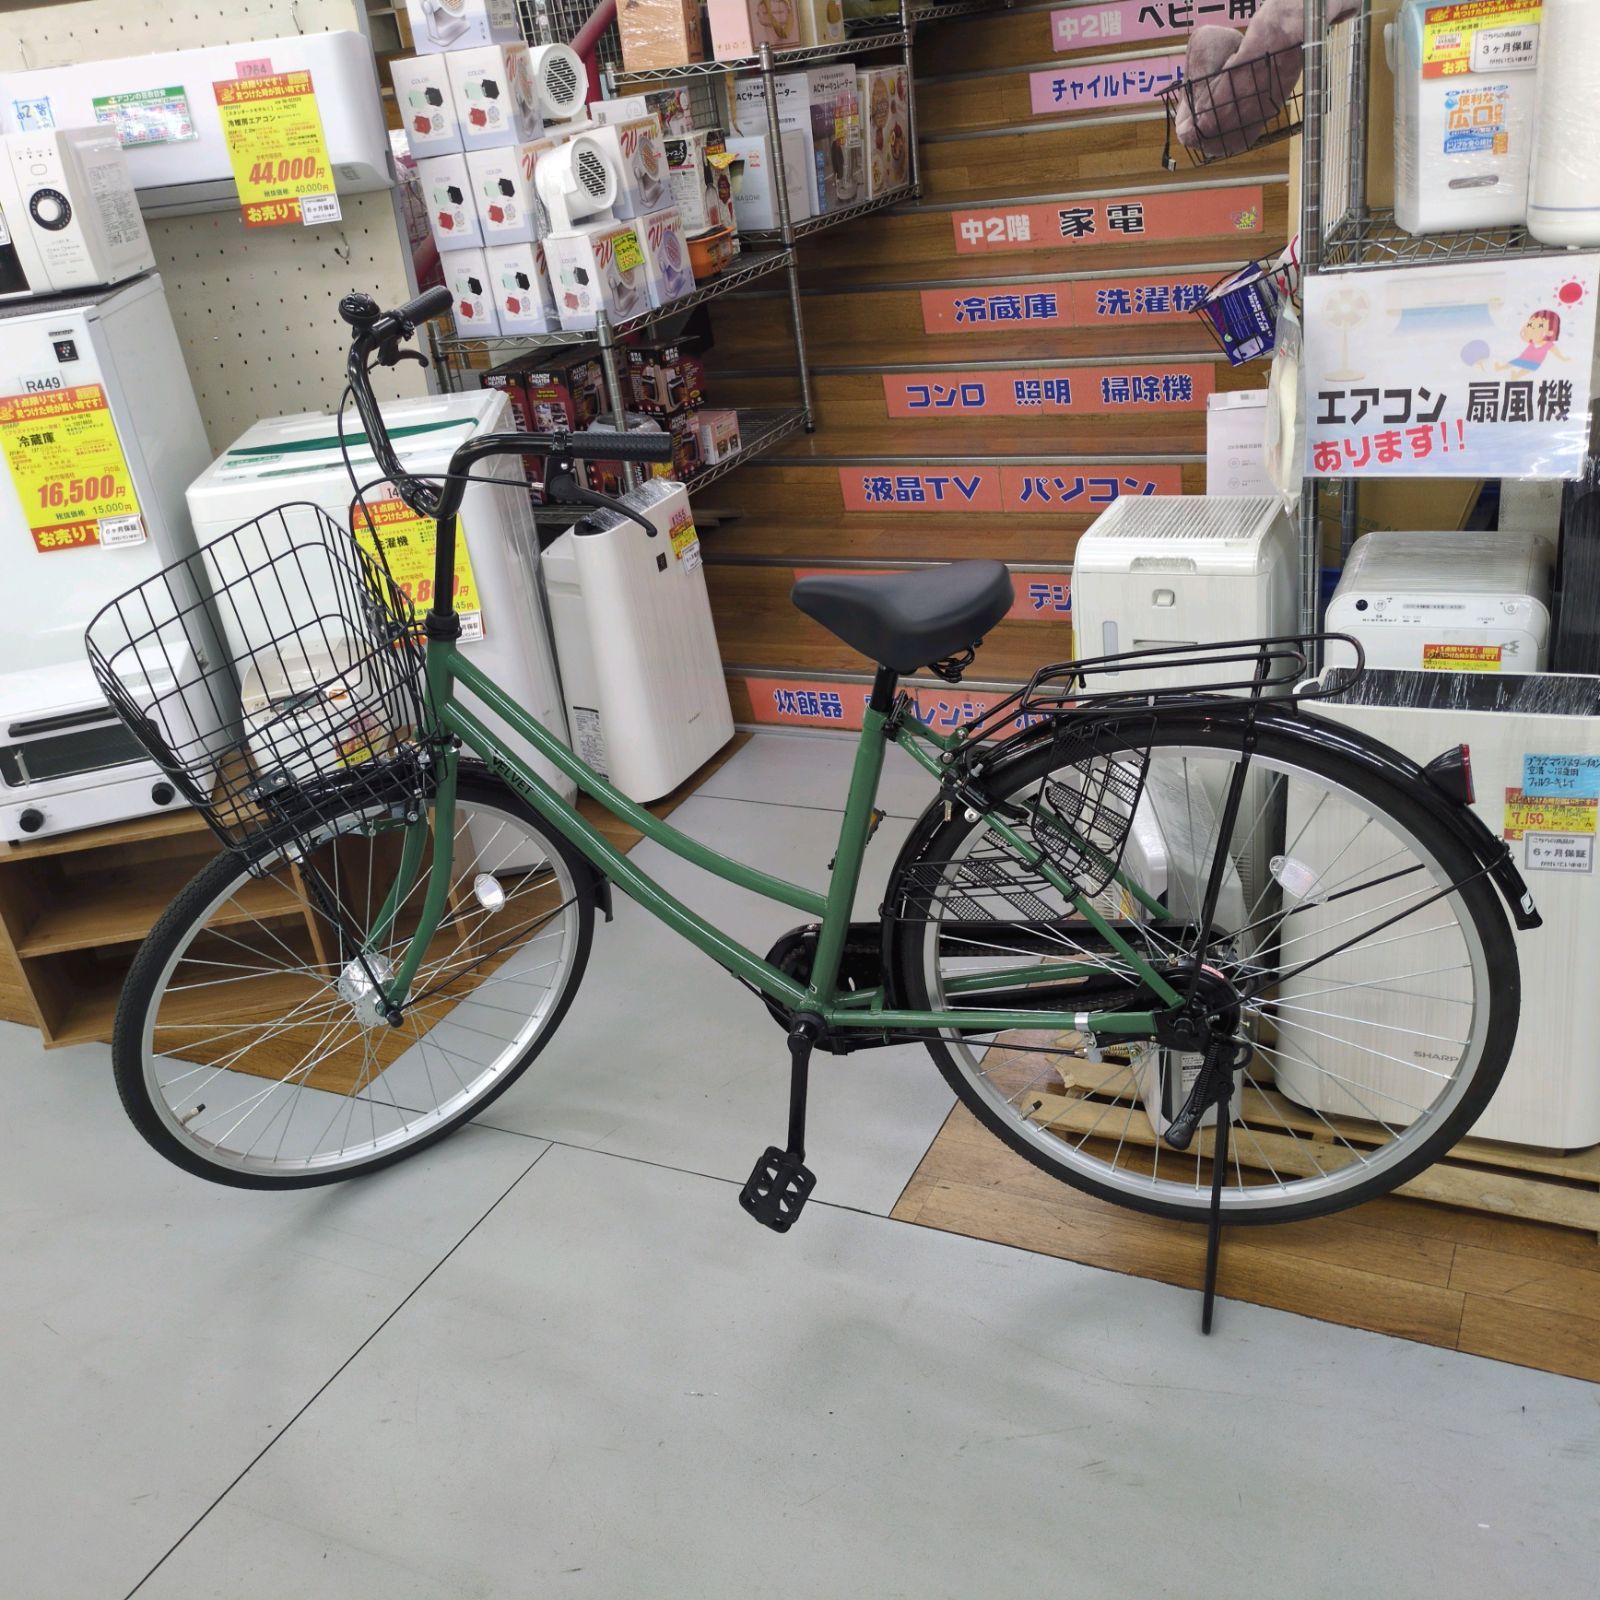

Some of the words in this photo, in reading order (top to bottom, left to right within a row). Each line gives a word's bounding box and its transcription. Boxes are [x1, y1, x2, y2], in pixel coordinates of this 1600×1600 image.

[1058, 11, 1122, 42] 中2階
[1138, 0, 1264, 29] ベビー用
[249, 156, 325, 186] 44,000円
[960, 214, 1031, 245] 中2階
[954, 292, 1059, 323] 冷蔵庫
[1096, 284, 1208, 316] 洗濯機
[26, 377, 60, 392] R449
[905, 383, 986, 409] コンロ
[1014, 378, 1072, 407] 照明
[1101, 374, 1194, 404] 掃除機
[1317, 387, 1447, 425] エアコン
[1466, 379, 1573, 424] 扇風機
[18, 432, 56, 448] 冷蔵庫
[1313, 418, 1466, 473] あります!!
[38, 474, 126, 509] 16,500円
[863, 476, 982, 502] 液晶TV
[1020, 476, 1157, 502] パソコン
[93, 503, 132, 515] 15,000円
[773, 688, 845, 719] 炊飯器
[493, 756, 534, 794] VELVET
[1413, 1050, 1460, 1061] SHARP
